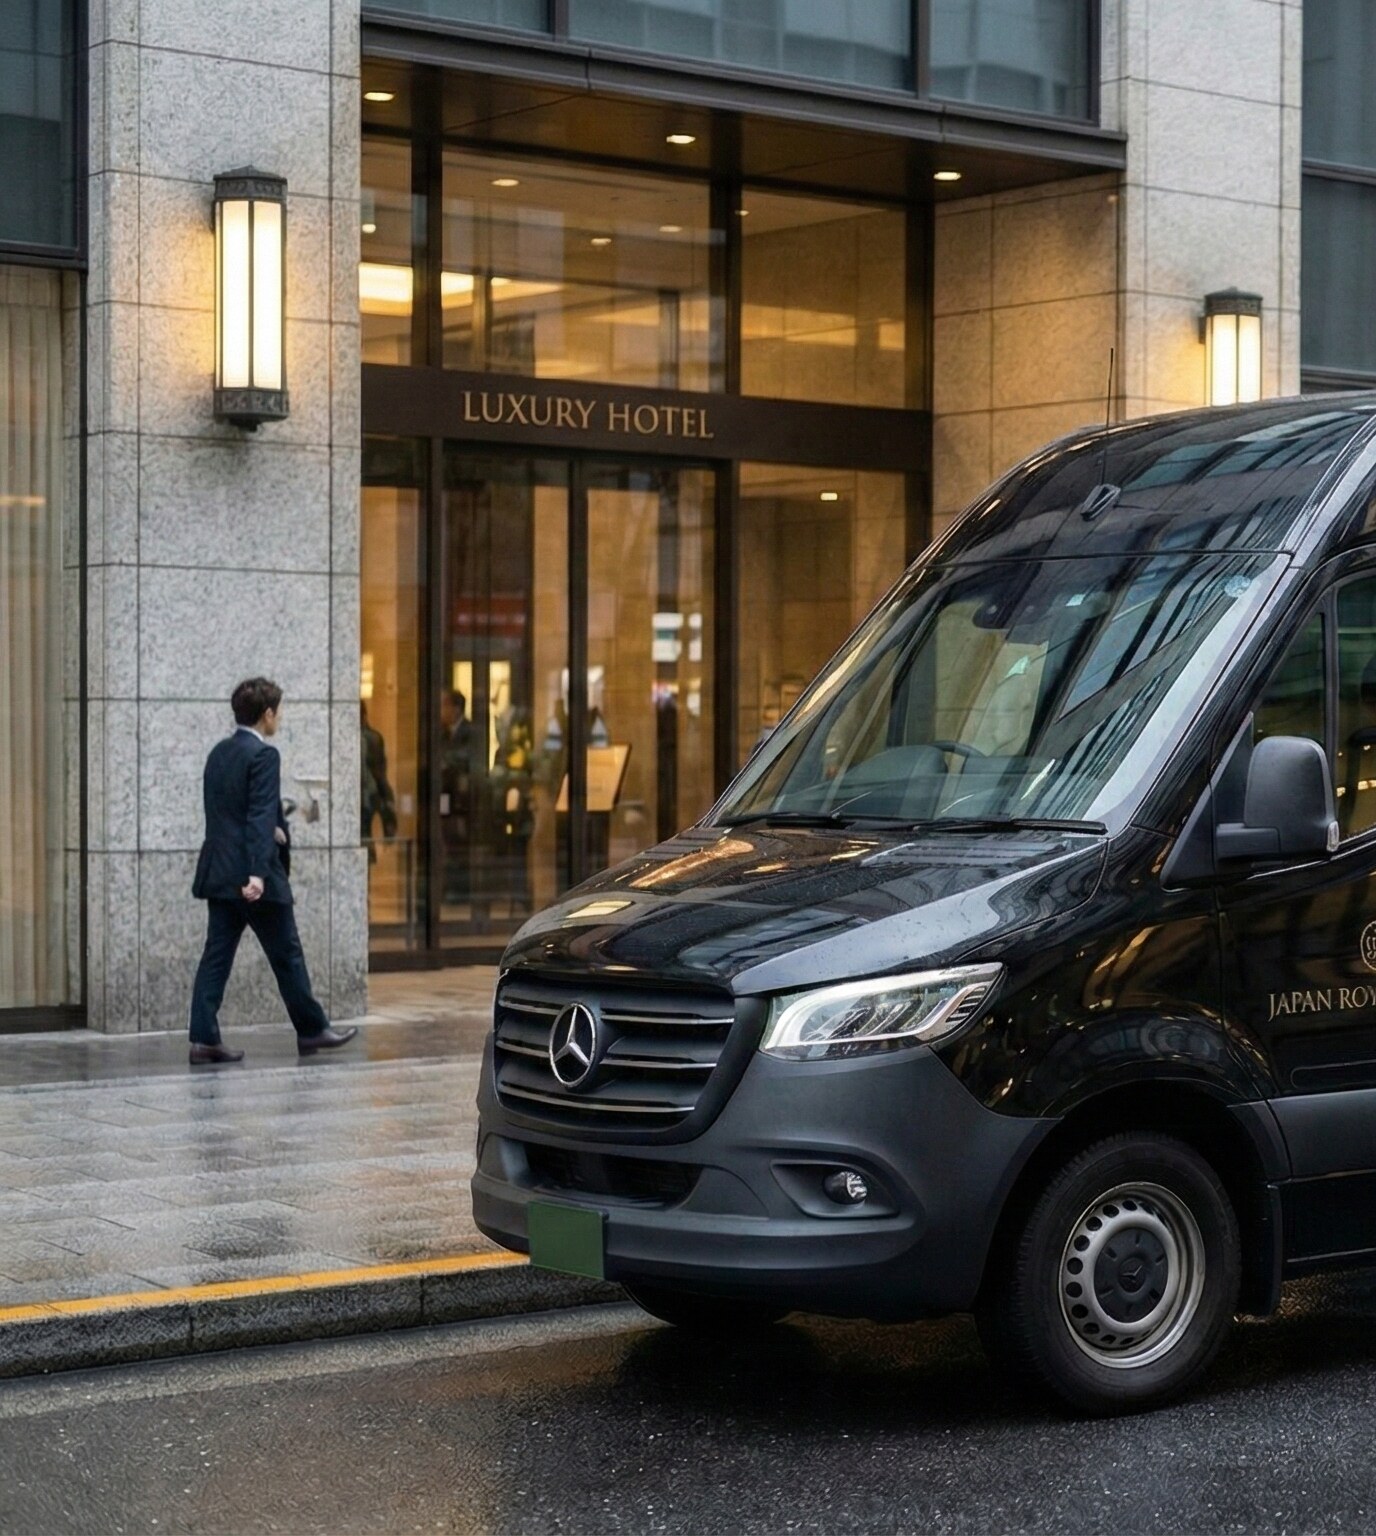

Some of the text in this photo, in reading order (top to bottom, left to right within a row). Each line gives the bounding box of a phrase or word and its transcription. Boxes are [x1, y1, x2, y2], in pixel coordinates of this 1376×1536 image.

[462, 391, 714, 438] LUXURY HOTEL
[1268, 989, 1332, 1022] JAPAN
